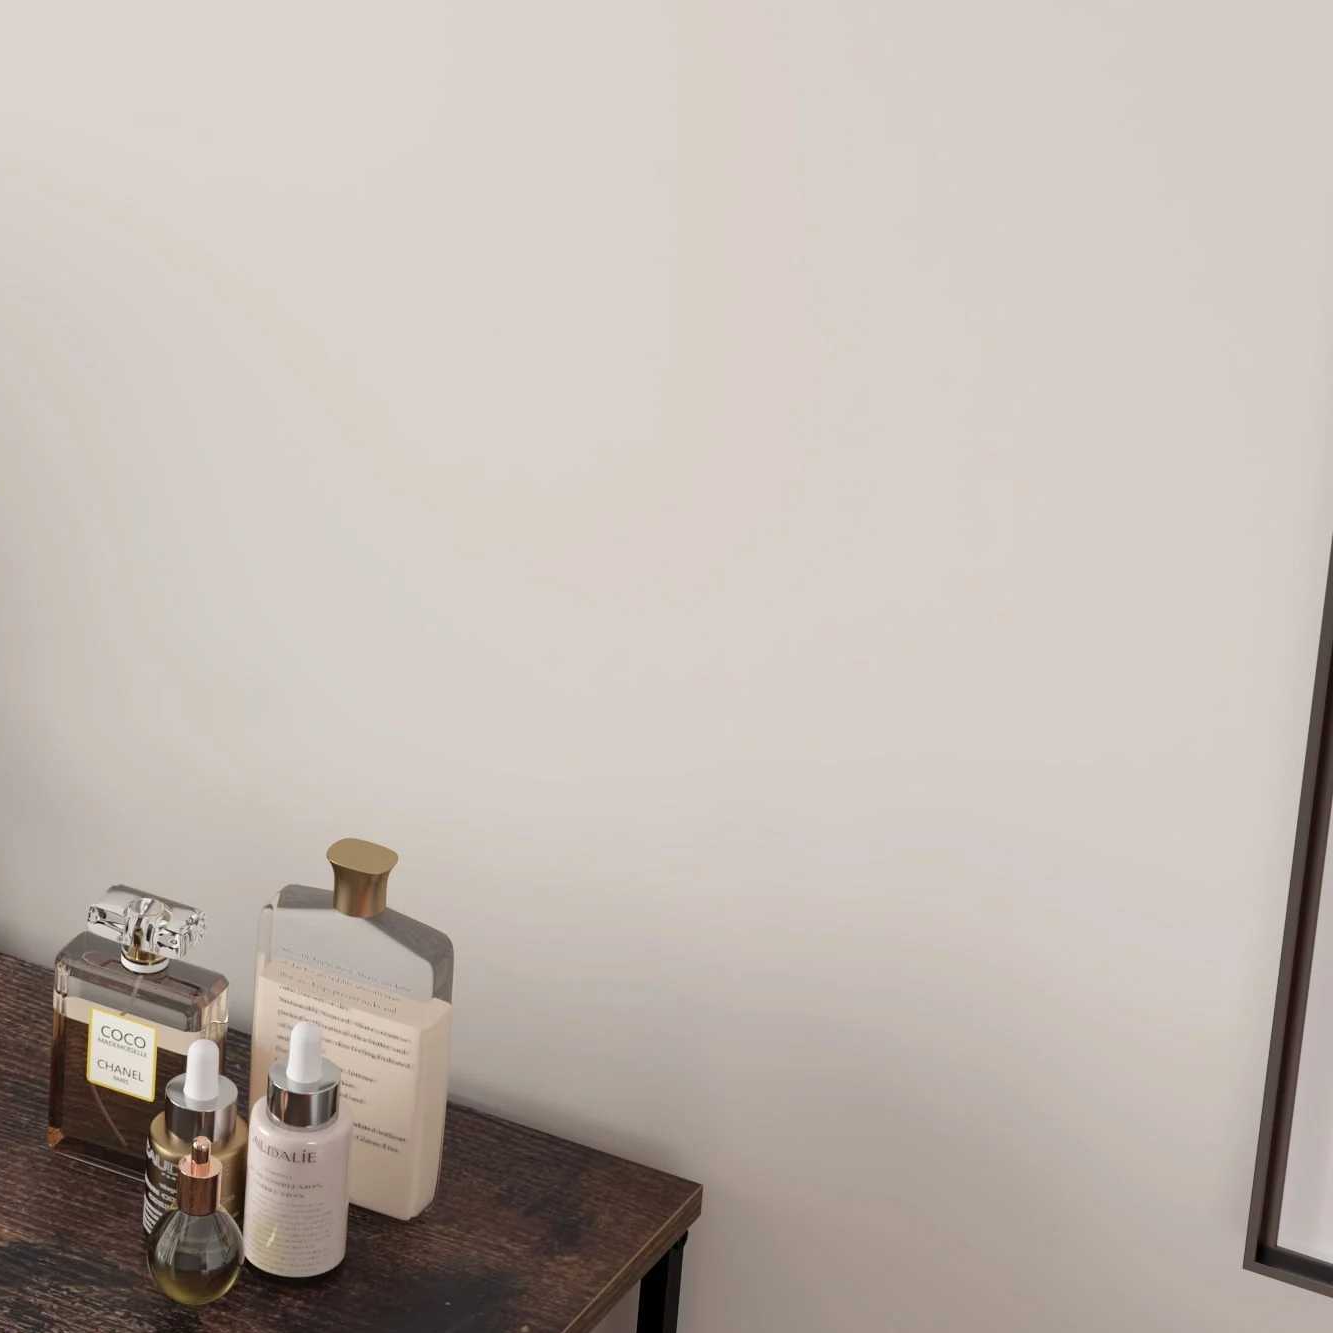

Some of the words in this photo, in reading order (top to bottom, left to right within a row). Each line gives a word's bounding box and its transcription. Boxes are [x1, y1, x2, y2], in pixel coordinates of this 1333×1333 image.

[98, 1037, 147, 1058] MADEMOISELLE
[100, 1025, 146, 1049] COCO
[97, 1059, 144, 1082] CHANEL
[113, 1075, 129, 1085] PARIS
